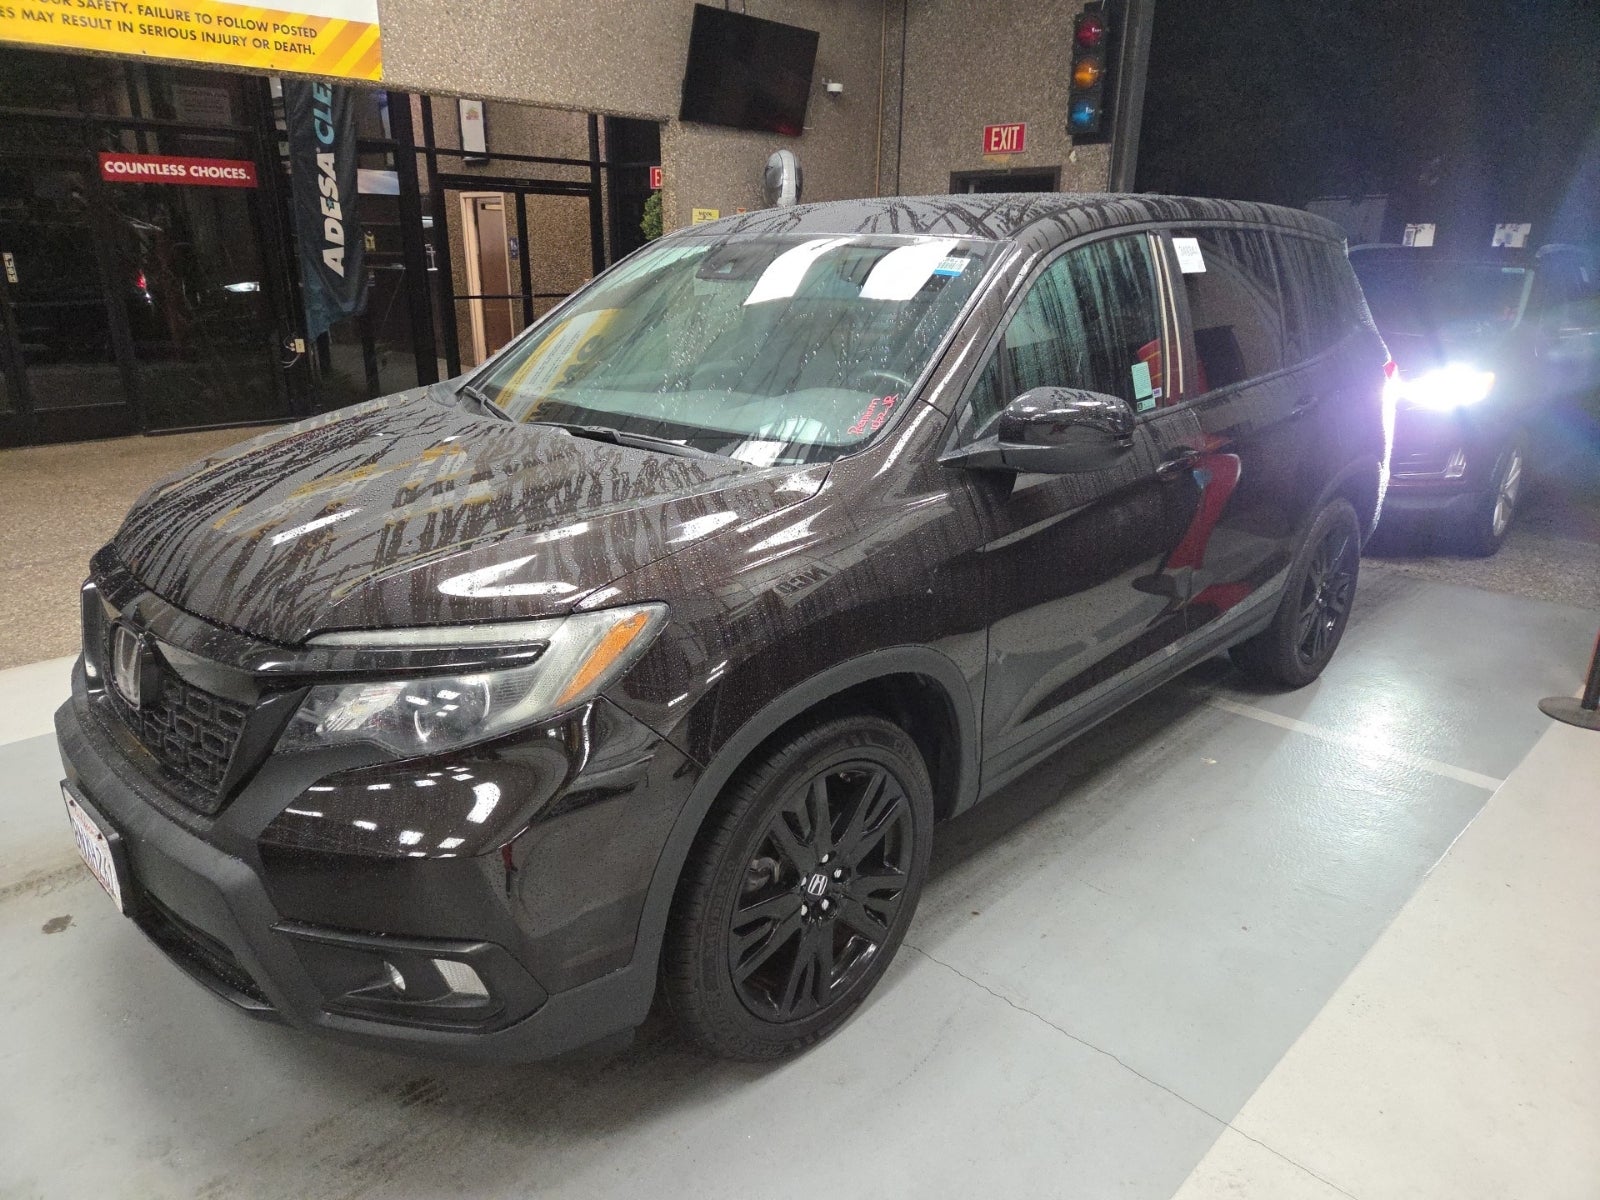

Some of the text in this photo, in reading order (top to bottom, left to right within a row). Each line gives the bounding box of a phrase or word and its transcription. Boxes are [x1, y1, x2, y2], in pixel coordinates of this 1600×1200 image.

[21, 8, 54, 23] MAY
[61, 13, 112, 31] RESULT
[117, 20, 134, 33] IN
[139, 23, 197, 41] SERIOUS
[201, 31, 247, 48] INJURY
[252, 38, 270, 50] OR
[274, 40, 316, 56] DEATH.
[77, 0, 132, 14] SAFETY.
[137, 4, 191, 22] FAILURE
[195, 12, 212, 25] TO
[217, 15, 268, 32] FOLLOW
[273, 23, 318, 39] POSTED
[990, 125, 1020, 151] EXIT
[104, 160, 251, 180] COUNTLESS CHOICES.
[316, 152, 345, 278] ADESA
